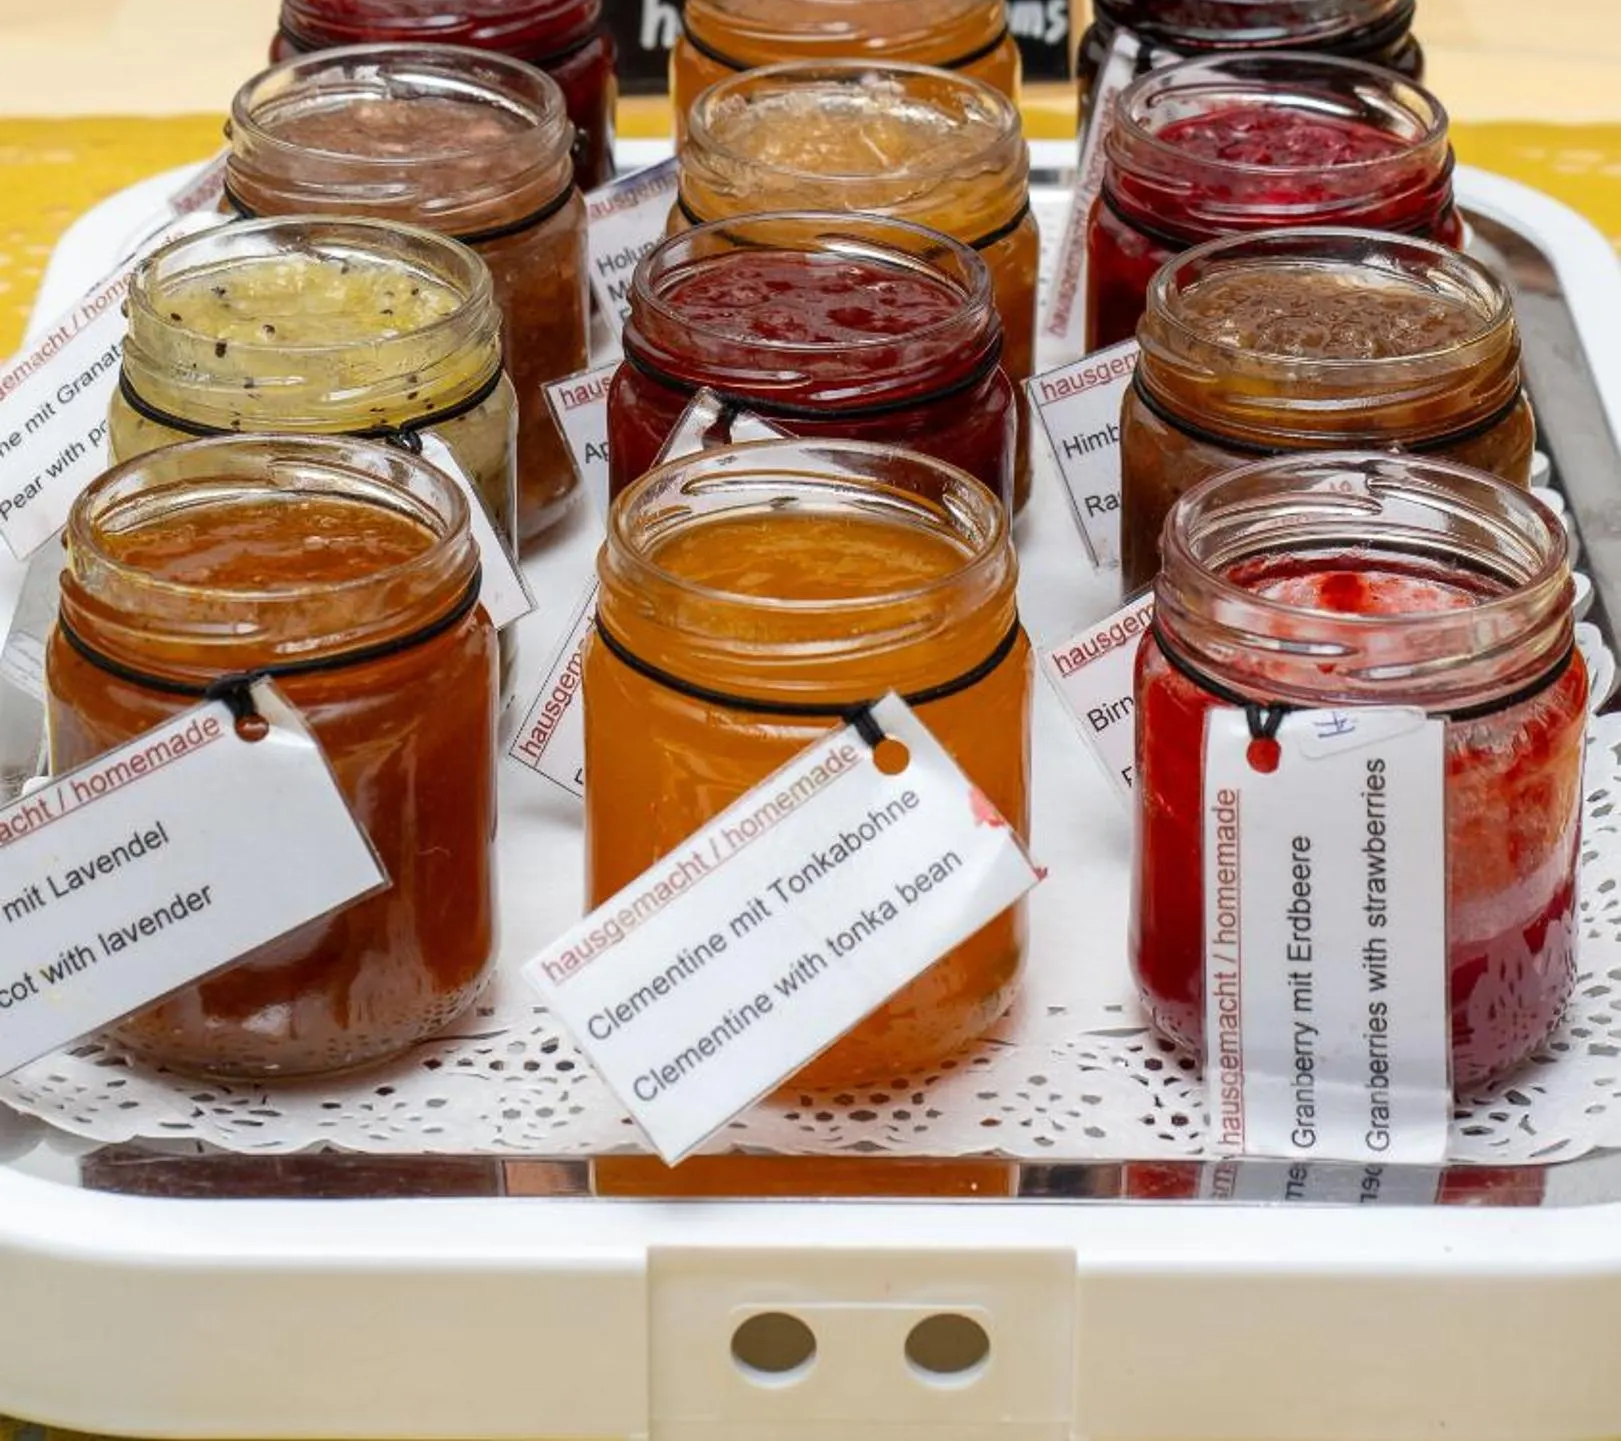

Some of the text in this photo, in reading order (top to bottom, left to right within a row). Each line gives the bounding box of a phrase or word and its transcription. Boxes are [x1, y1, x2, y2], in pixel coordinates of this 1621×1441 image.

[25, 401, 56, 434] mit
[1040, 352, 1137, 401] hausgem
[0, 475, 43, 522] Pear
[45, 440, 86, 479] with
[1062, 423, 1120, 459] Himb
[1052, 604, 1153, 674] hausgem
[519, 642, 584, 758] hausgem
[1087, 696, 1134, 733] Birn
[57, 714, 222, 810] / homemade
[2, 885, 47, 923] mit
[47, 821, 170, 899] Lavendel
[540, 740, 861, 985] hausgemacht / homemade
[1211, 789, 1237, 945] homemade
[1360, 757, 1386, 929] strawberries
[40, 882, 215, 985] with lavender
[586, 786, 921, 1042] Clementine mit Tonkabohne
[1286, 835, 1311, 962] Erdbeere
[632, 849, 964, 1104] Clementine with tonka bean
[1212, 953, 1237, 965] /
[1287, 971, 1312, 1012] mit
[1361, 938, 1387, 993] with
[1212, 970, 1241, 1146] hausgemacht
[1290, 1020, 1319, 1149] Granberry
[1363, 1001, 1390, 1152] Granberries
